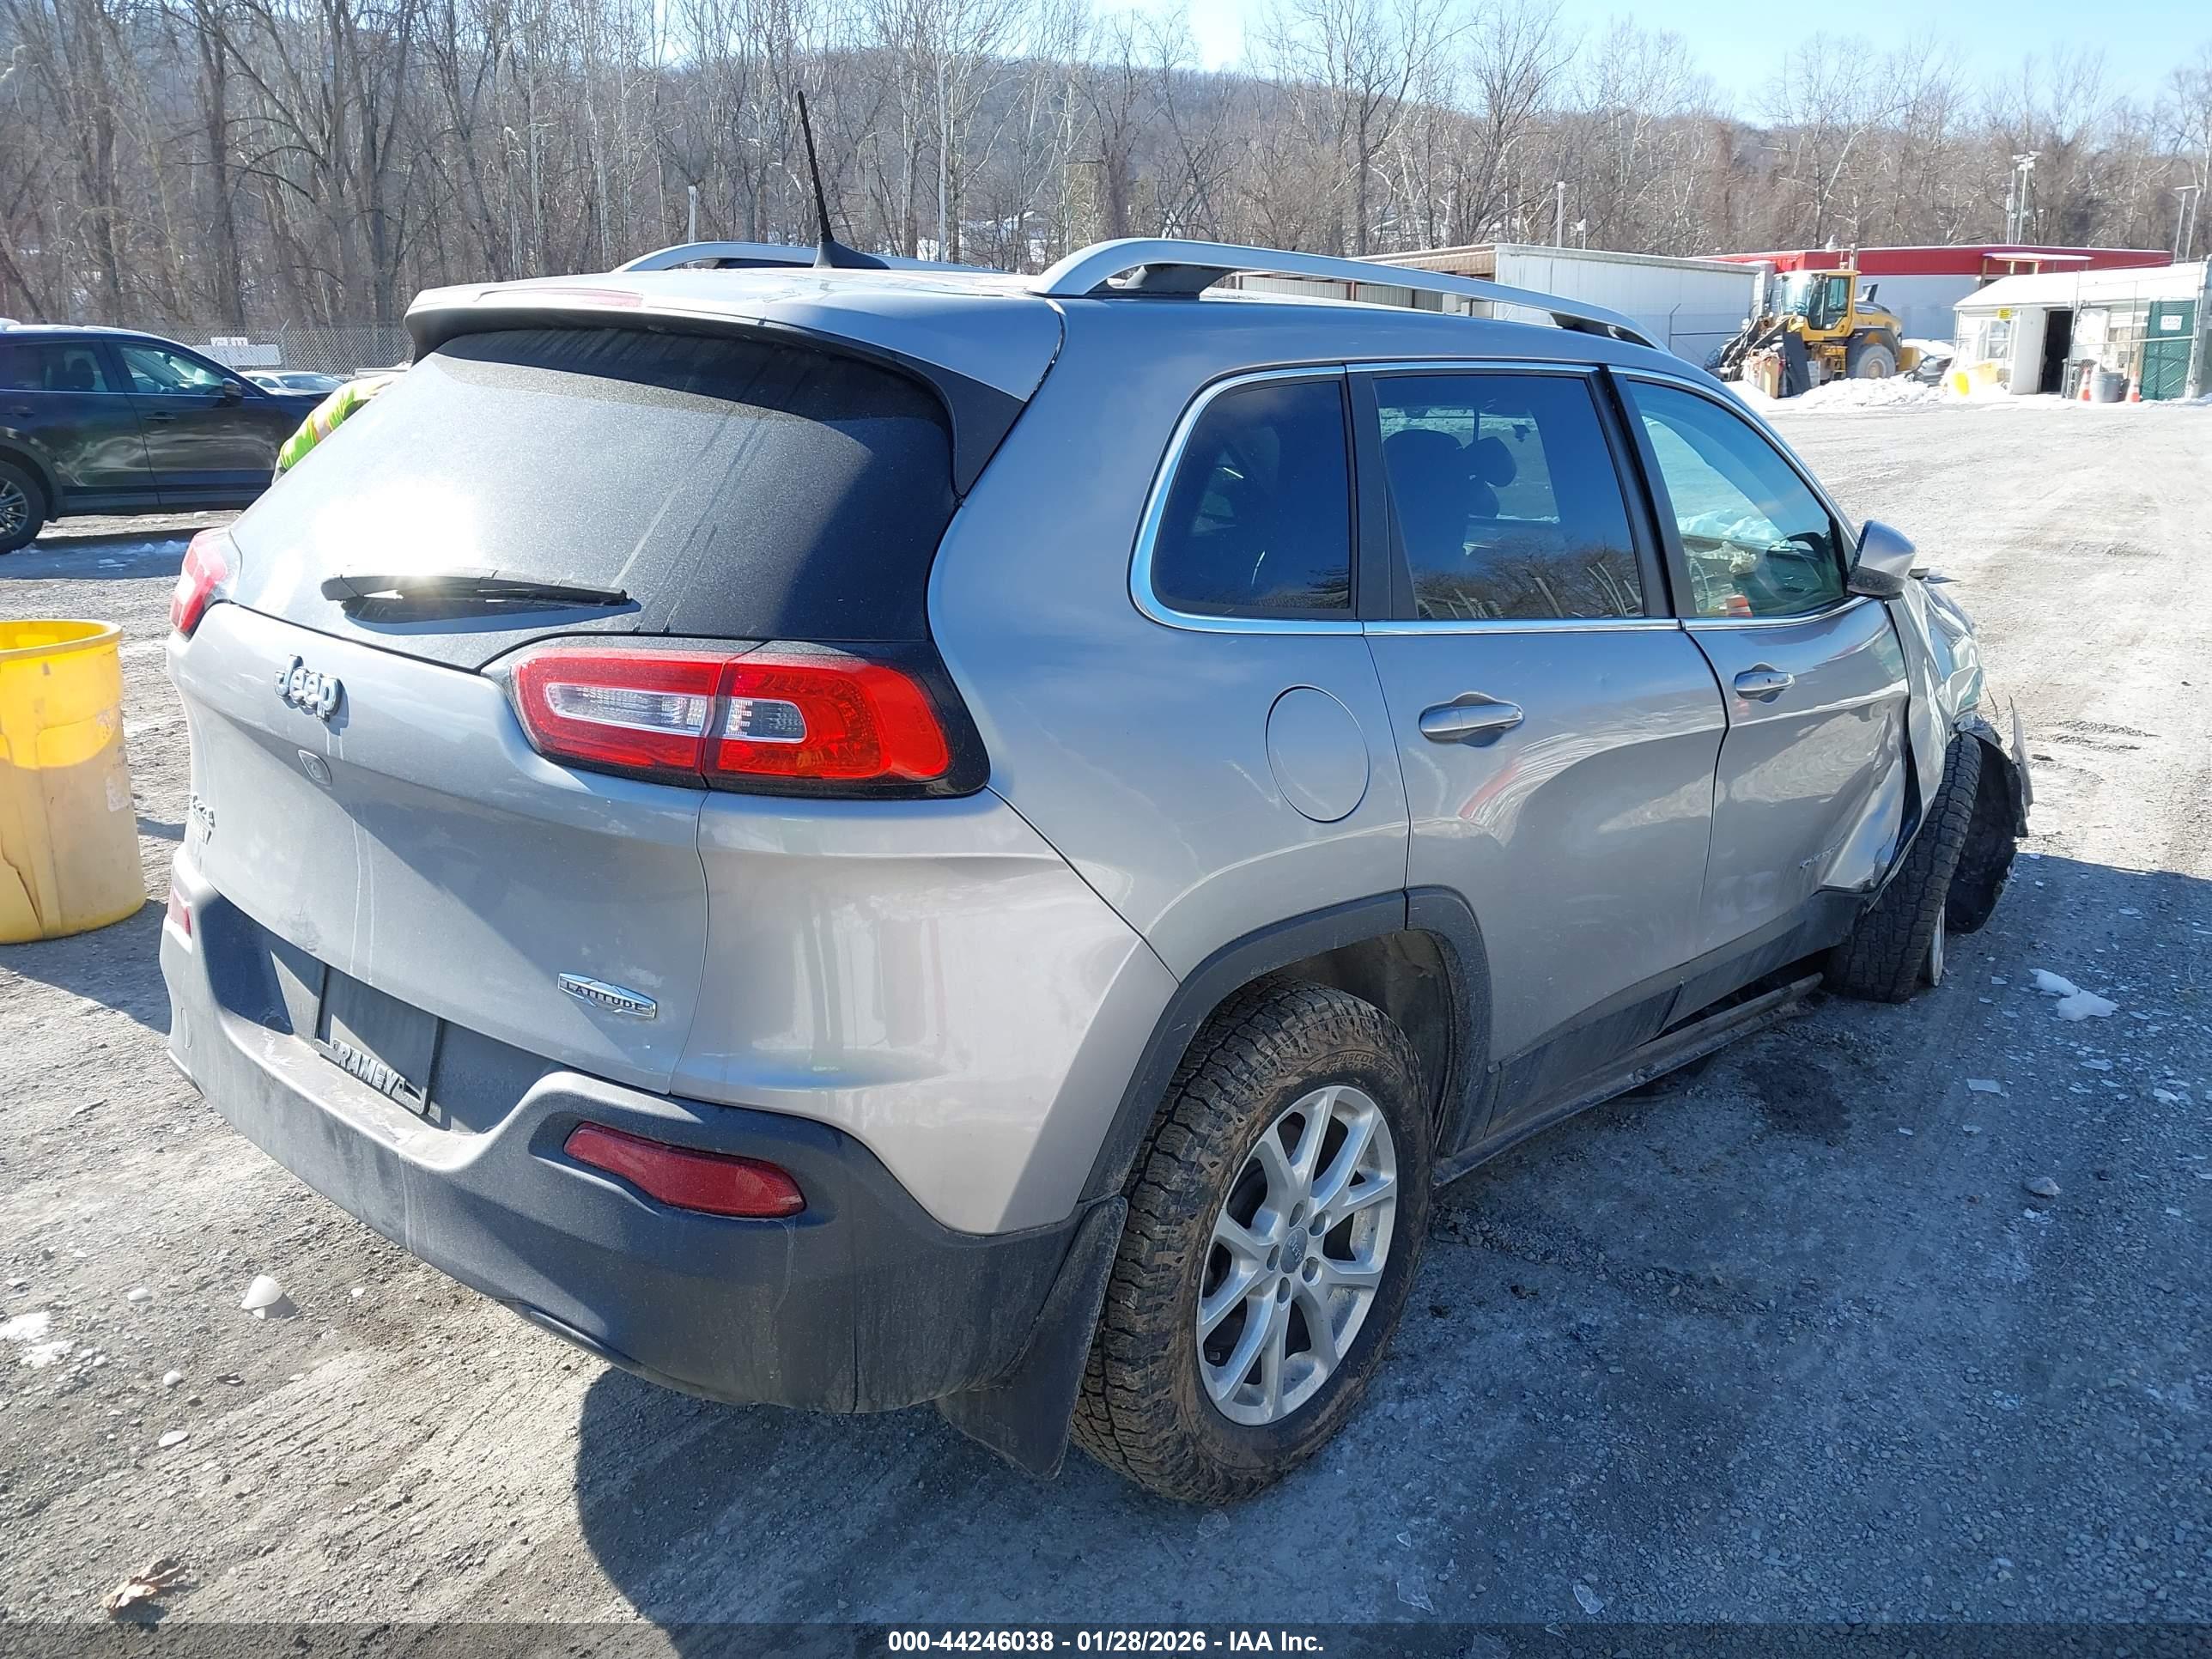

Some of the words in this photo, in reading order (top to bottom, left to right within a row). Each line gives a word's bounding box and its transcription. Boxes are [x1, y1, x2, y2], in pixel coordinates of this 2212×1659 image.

[275, 653, 342, 721] Jeep
[565, 981, 647, 1012] LATITUDE
[335, 1041, 401, 1097] RAMEY
